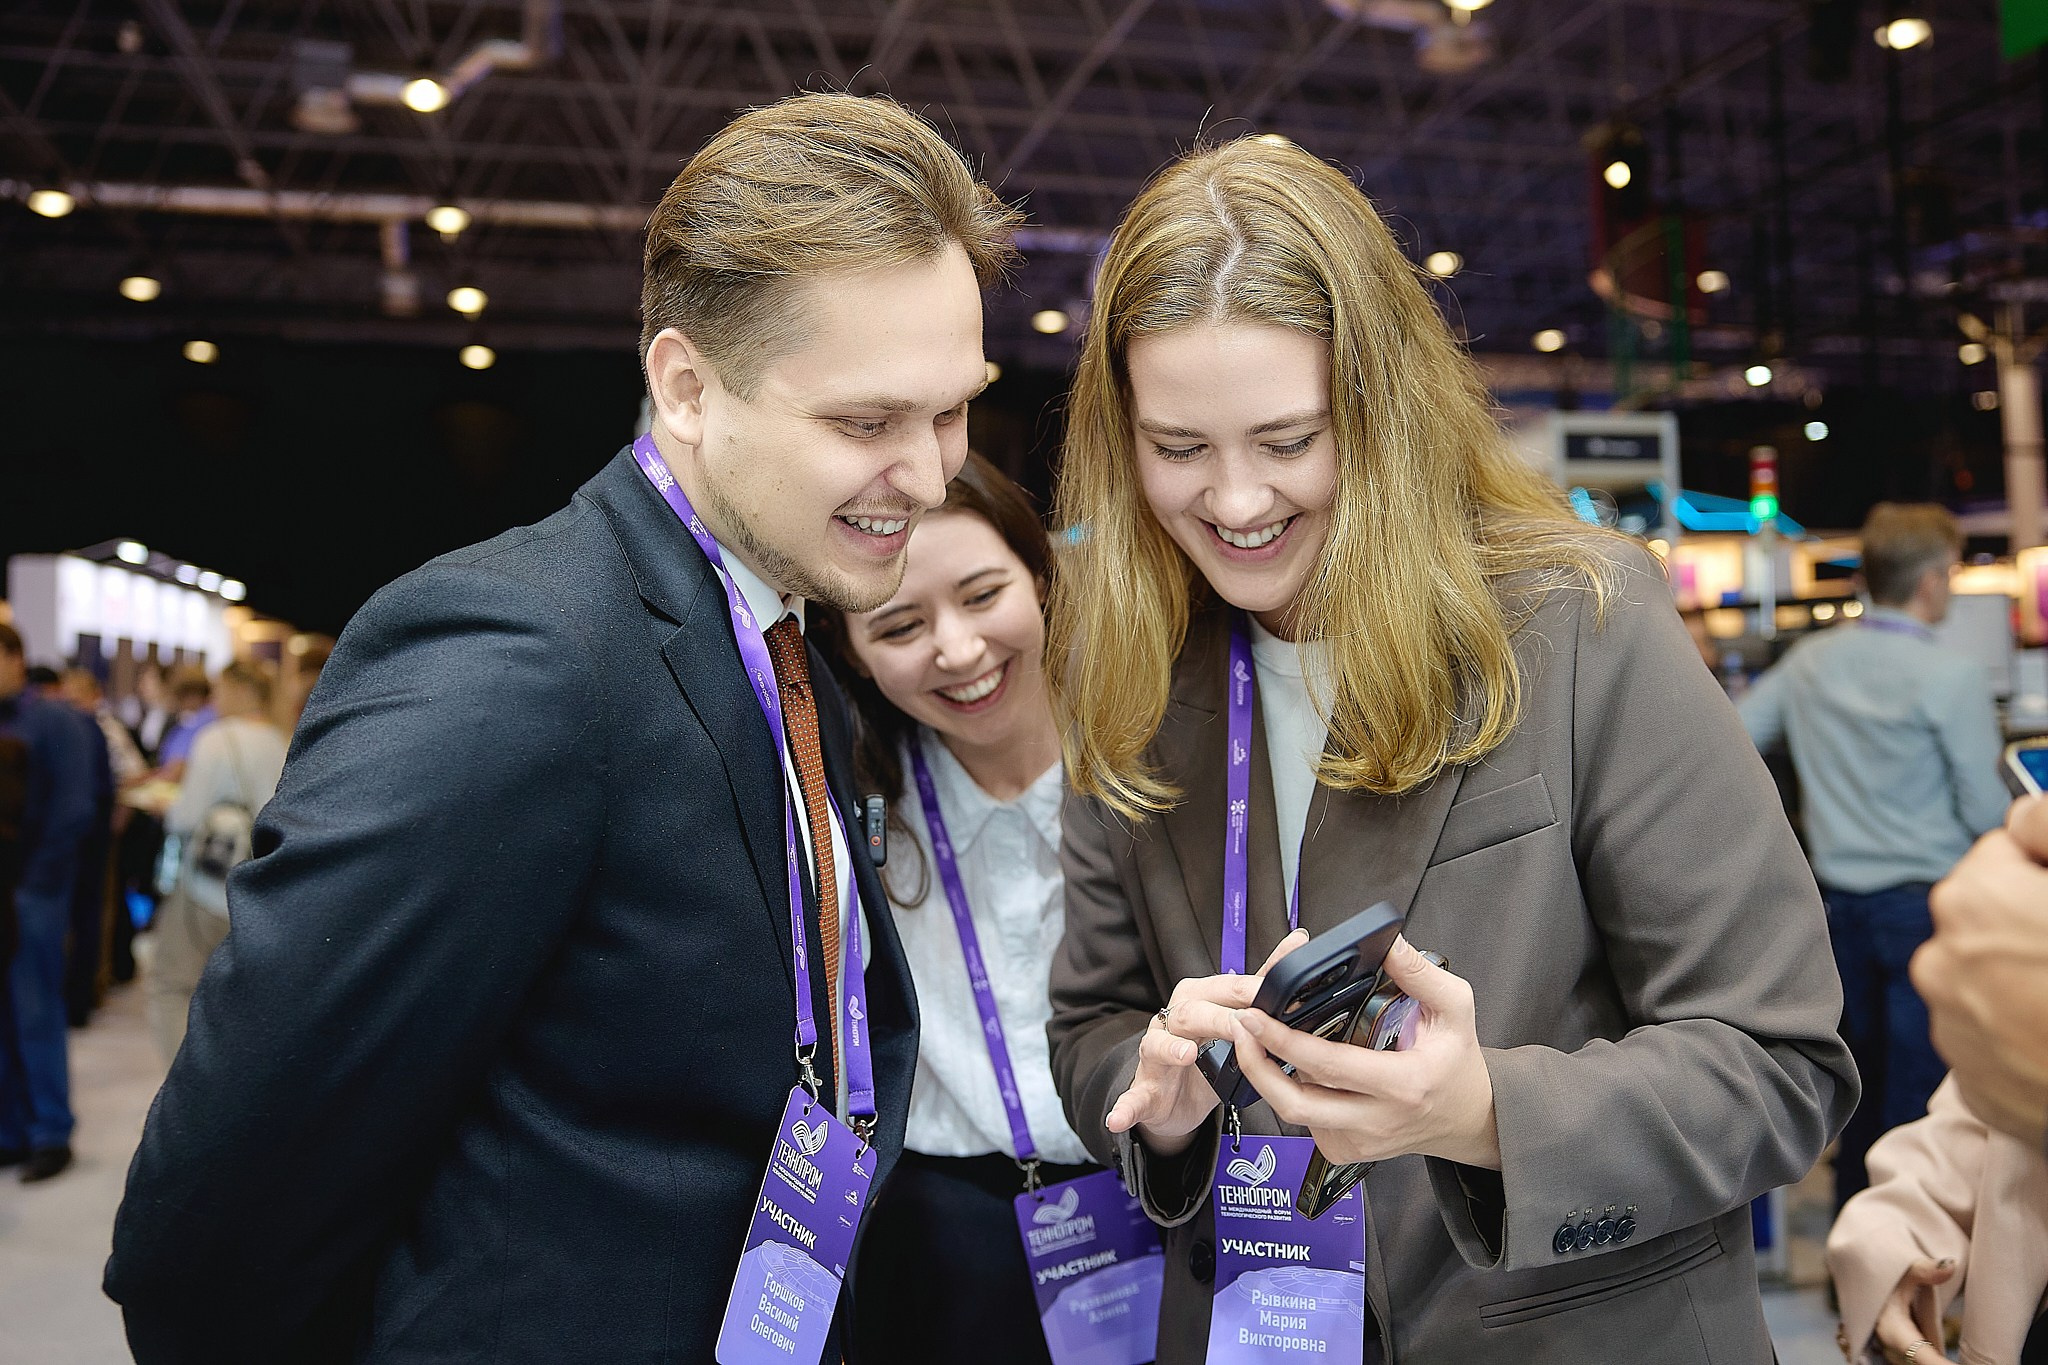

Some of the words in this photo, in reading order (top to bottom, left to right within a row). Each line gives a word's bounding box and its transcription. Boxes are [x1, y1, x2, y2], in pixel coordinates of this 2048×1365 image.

[777, 1138, 824, 1191] ТЕХНОПРОМ
[1218, 1185, 1291, 1208] ТЕХНОПРОМ
[760, 1195, 818, 1250] УЧАСТНИК
[1036, 1249, 1118, 1285] УЧАСТНИК
[1222, 1238, 1311, 1261] УЧАСТНИК
[763, 1271, 805, 1312] Горшков
[1251, 1289, 1317, 1311] Рывкина
[758, 1293, 799, 1333] Василий
[1259, 1310, 1307, 1331] Мария
[750, 1313, 796, 1355] Олегович
[1238, 1327, 1327, 1353] Викторовна
